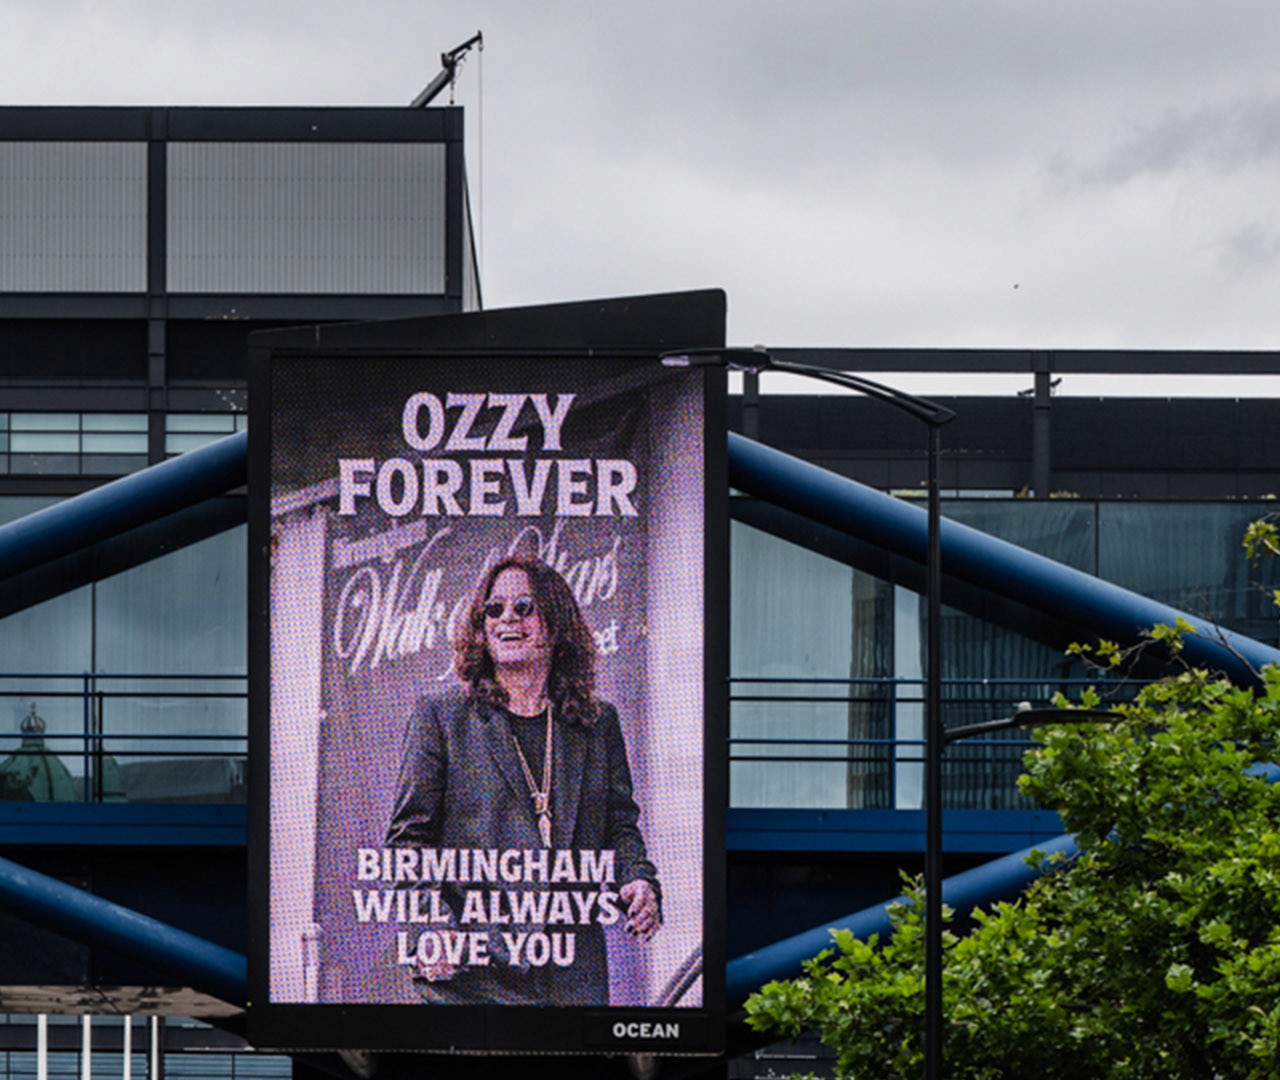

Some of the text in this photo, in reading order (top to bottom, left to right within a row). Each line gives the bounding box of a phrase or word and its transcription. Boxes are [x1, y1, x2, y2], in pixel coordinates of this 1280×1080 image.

[401, 391, 577, 452] OZZY
[337, 457, 639, 517] FOREVER
[356, 847, 617, 884] BIRMINGHAM
[352, 888, 620, 925] WILL ALWAYS
[396, 930, 576, 967] LOVE YOU
[612, 1022, 680, 1039] OCEAN
